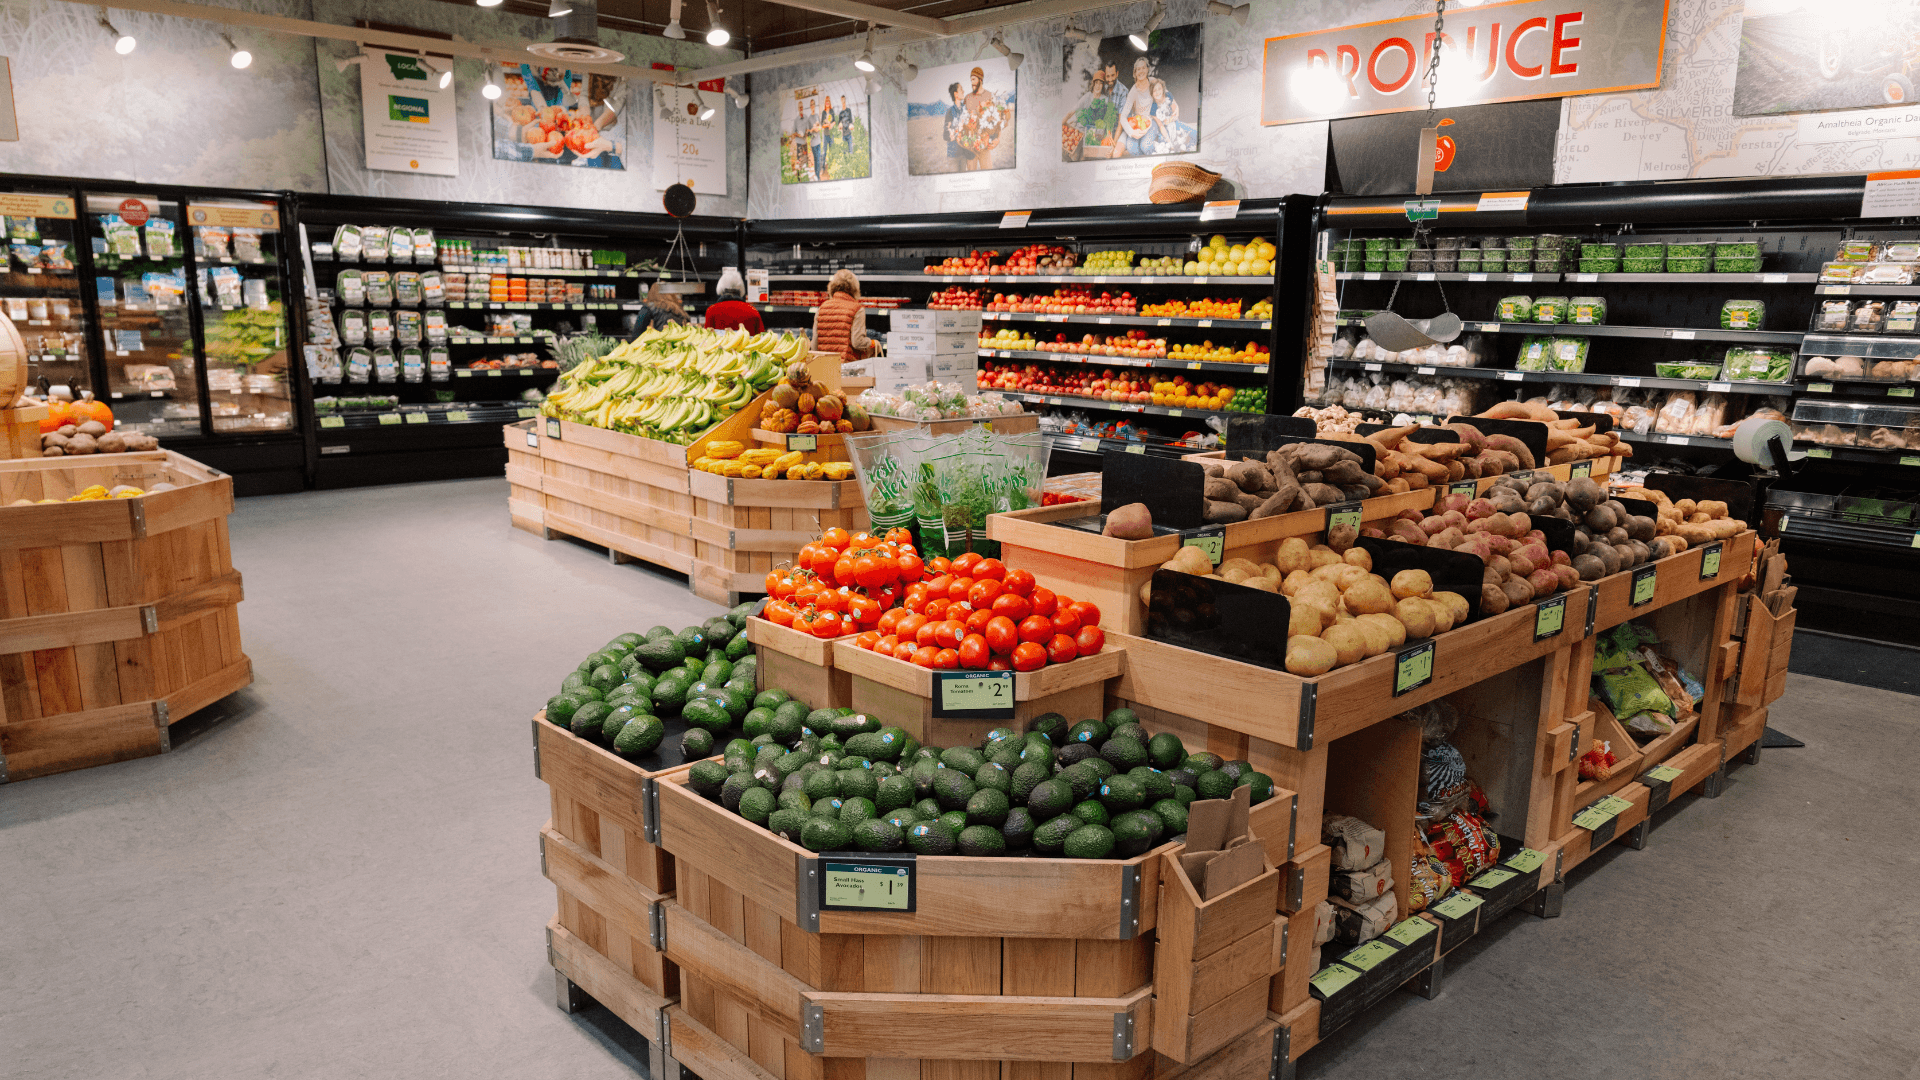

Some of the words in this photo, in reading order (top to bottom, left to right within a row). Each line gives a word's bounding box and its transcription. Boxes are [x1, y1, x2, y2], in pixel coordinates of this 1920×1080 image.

[393, 104, 425, 113] REGIONAL
[1865, 116, 1902, 127] Organic
[1623, 131, 1662, 143] Dewey
[1716, 139, 1780, 152] Silverstar
[1643, 162, 1689, 173] Melrose
[1351, 516, 1357, 527] 2
[1210, 541, 1216, 553] 2
[993, 683, 1003, 697] 2
